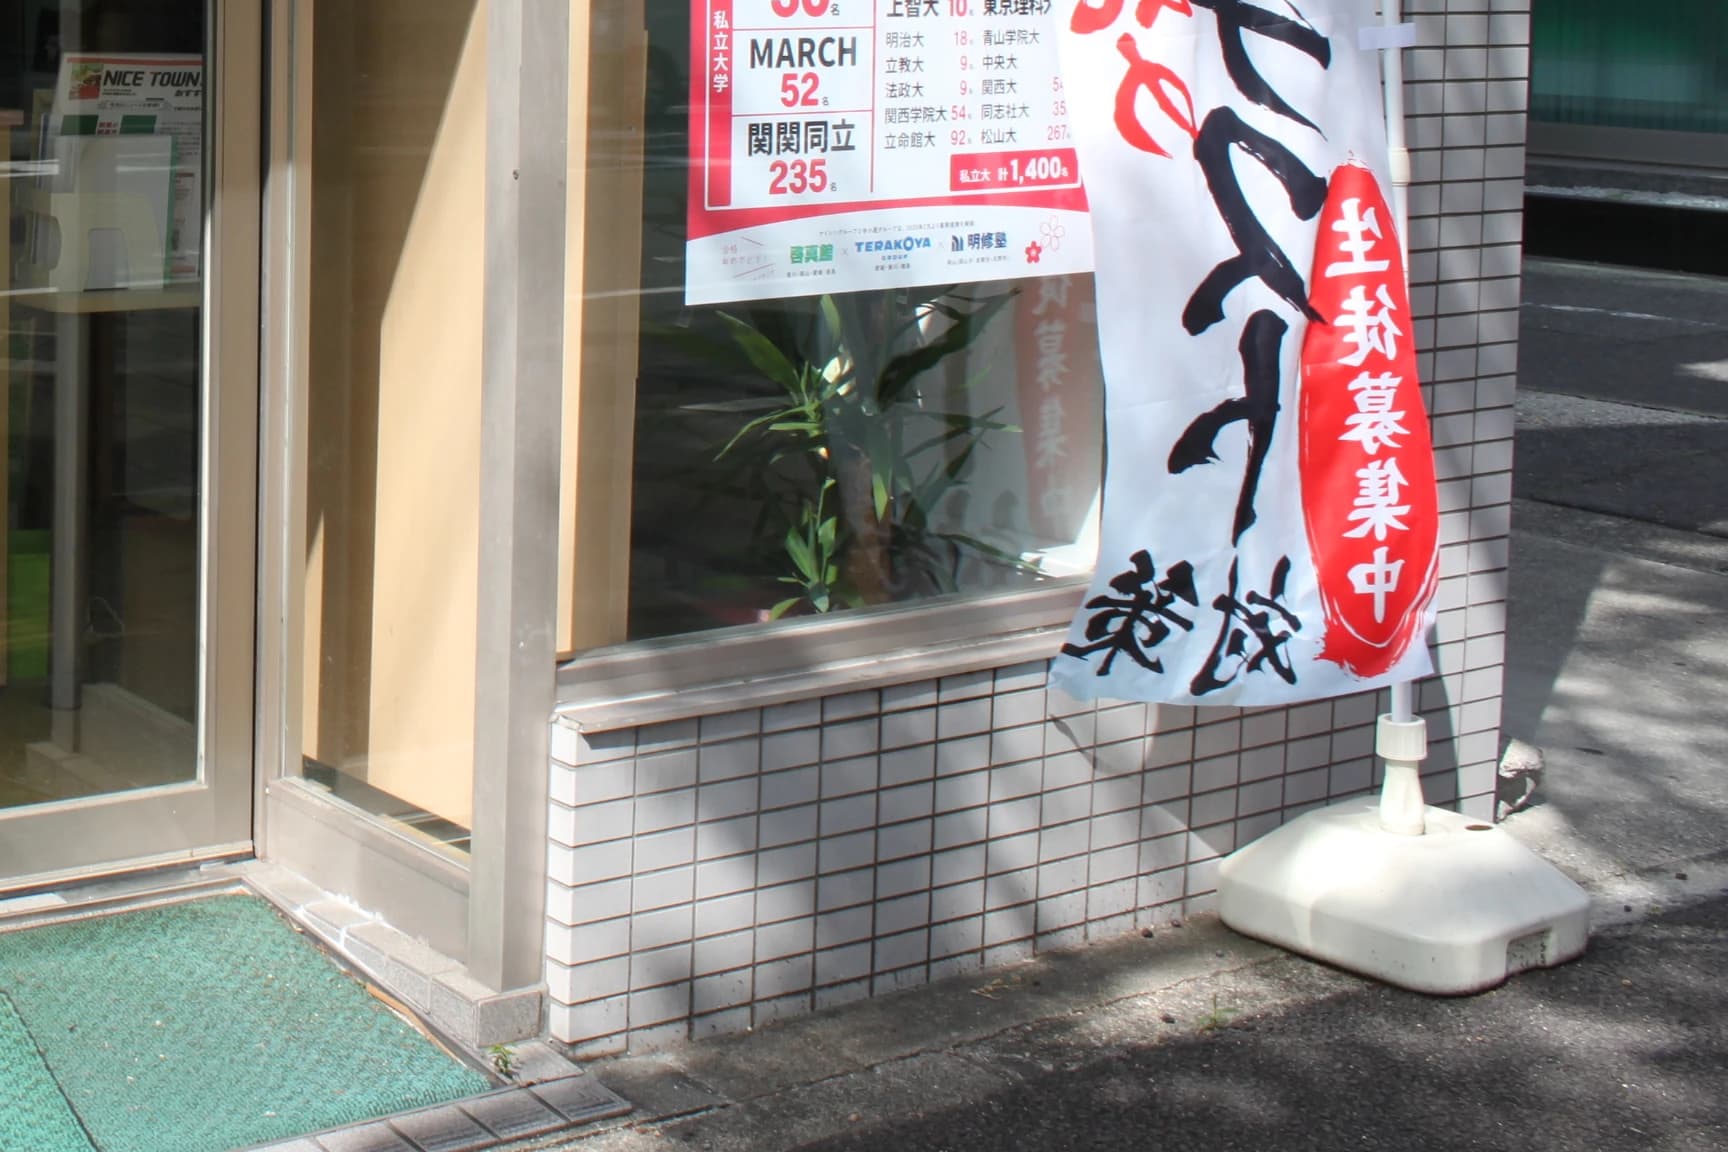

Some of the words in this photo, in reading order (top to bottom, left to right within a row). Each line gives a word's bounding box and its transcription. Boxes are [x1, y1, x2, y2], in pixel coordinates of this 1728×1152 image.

[885, 31, 925, 48] 明治大
[983, 28, 1040, 46] 青山学院大
[713, 10, 729, 93] 私立大学
[750, 36, 857, 69] MARCH
[885, 56, 925, 74] 立教大
[982, 53, 1018, 71] 中央大
[103, 69, 144, 87] NICE
[981, 78, 1018, 95] 関西大
[885, 81, 925, 99] 法政大
[884, 105, 948, 124] 関西学院大
[981, 103, 1030, 121] 同志社大
[748, 118, 856, 157] 関関同立
[884, 131, 936, 149] 立命館大
[981, 128, 1018, 145] 松山大
[959, 168, 991, 183] 私立大
[855, 236, 932, 253] TERAKOYA
